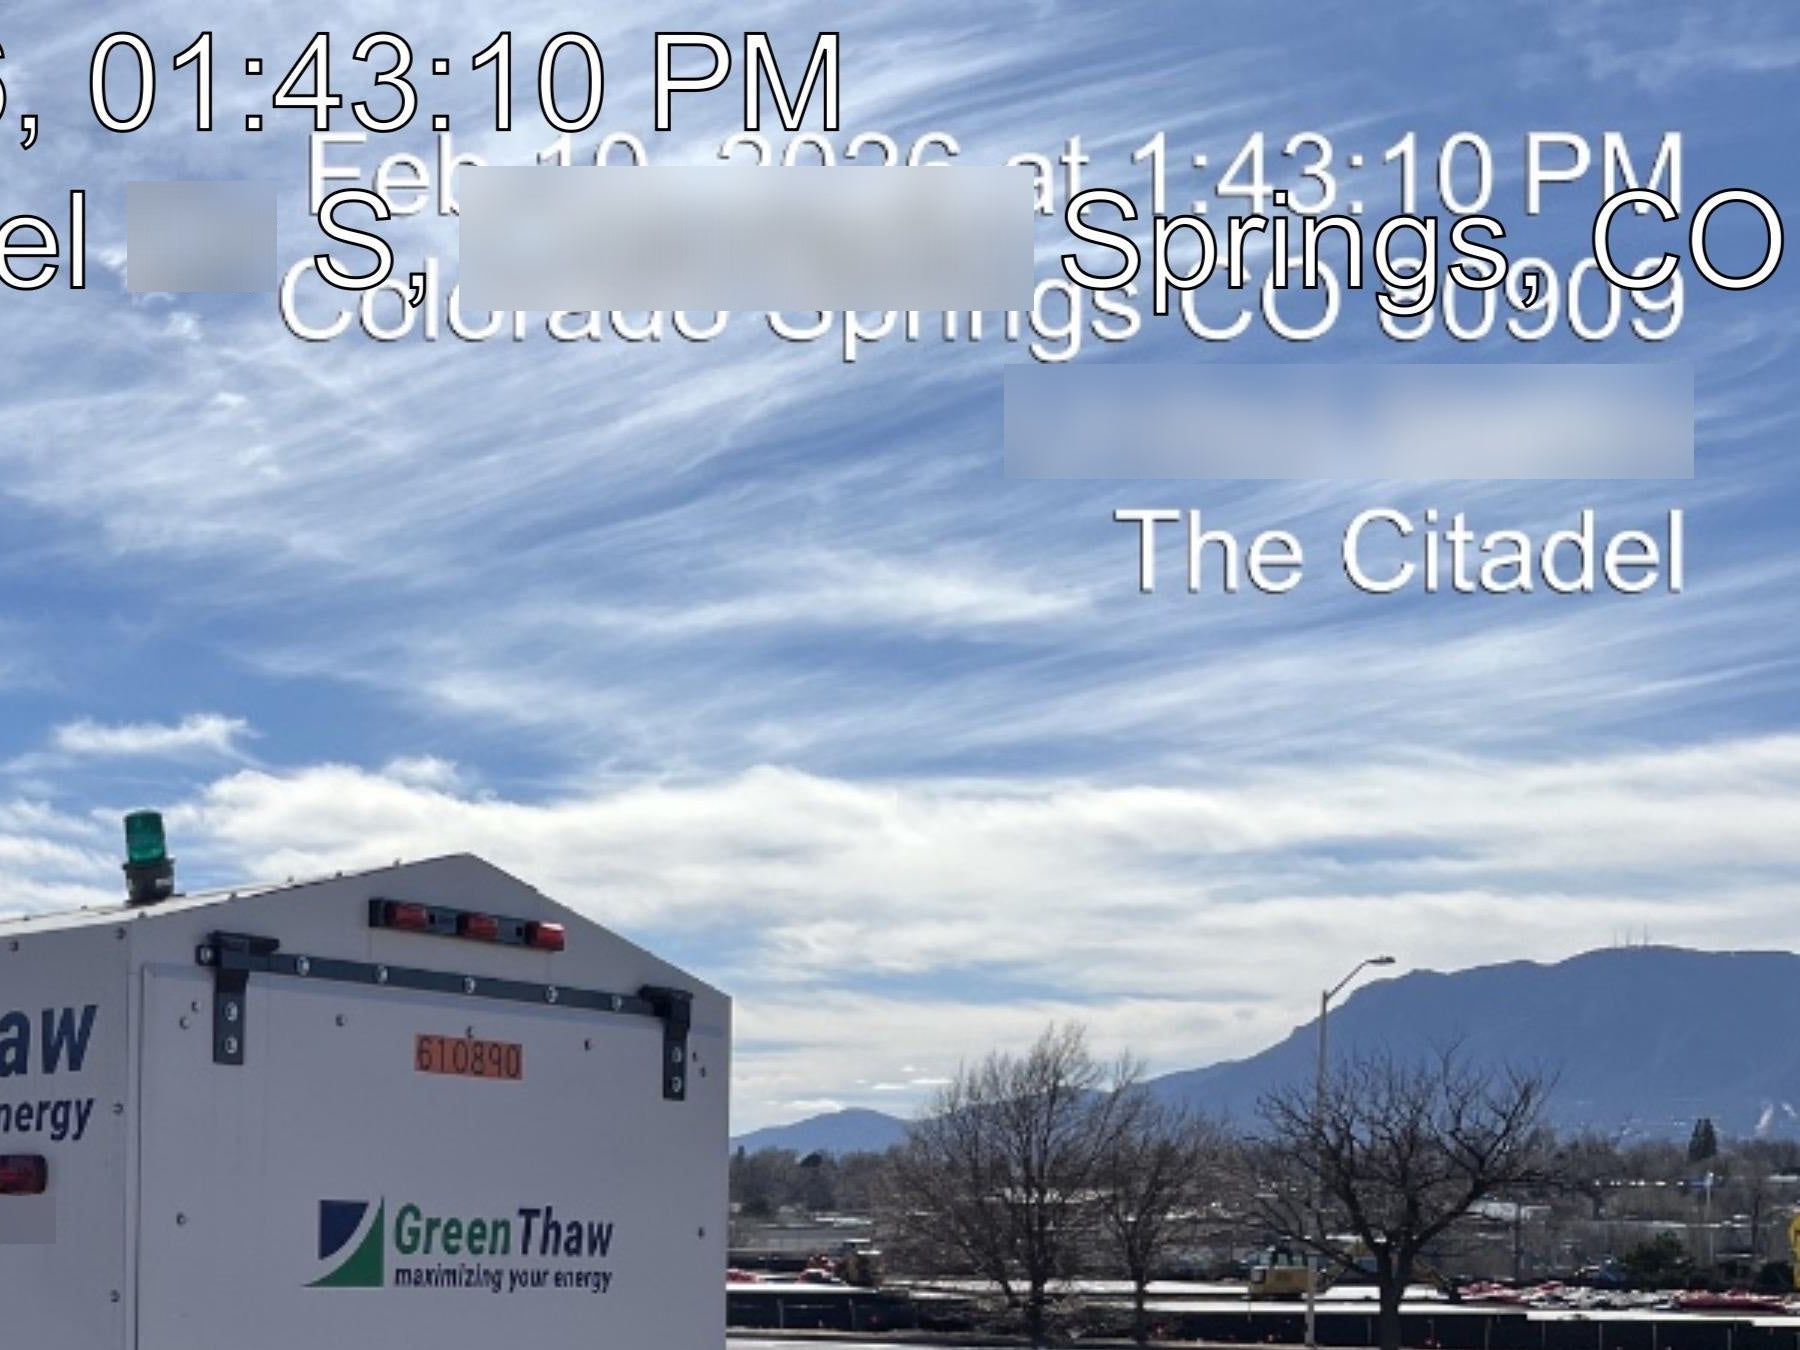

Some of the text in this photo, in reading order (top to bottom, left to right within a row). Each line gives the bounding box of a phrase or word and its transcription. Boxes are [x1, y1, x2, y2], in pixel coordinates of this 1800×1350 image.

[418, 1036, 521, 1079] 610890
[394, 1263, 614, 1294] maximizing your energy
